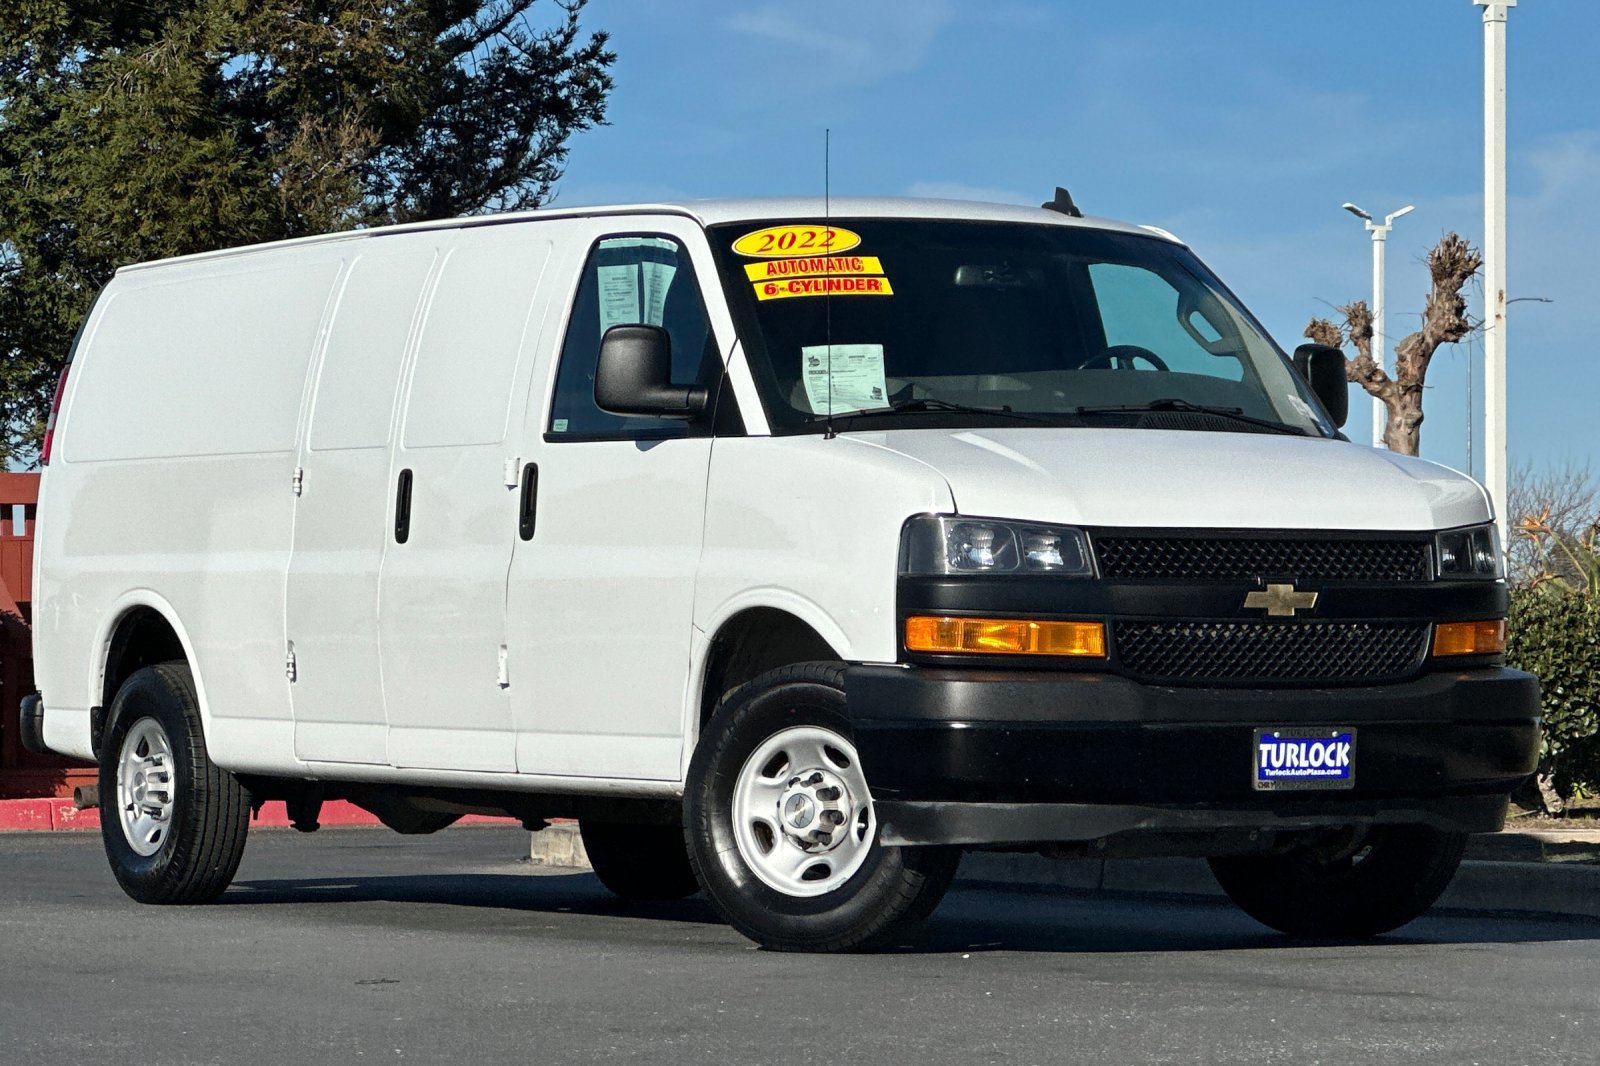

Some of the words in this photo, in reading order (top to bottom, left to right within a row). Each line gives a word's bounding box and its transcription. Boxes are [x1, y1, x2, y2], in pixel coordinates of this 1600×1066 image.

[756, 230, 836, 253] 2022
[766, 257, 865, 276] AUTOMATIC
[764, 278, 883, 296] 6-CYLINDER
[1259, 742, 1350, 768] TURLOCK
[1265, 768, 1342, 776] TurlockAutoPlaza.com
